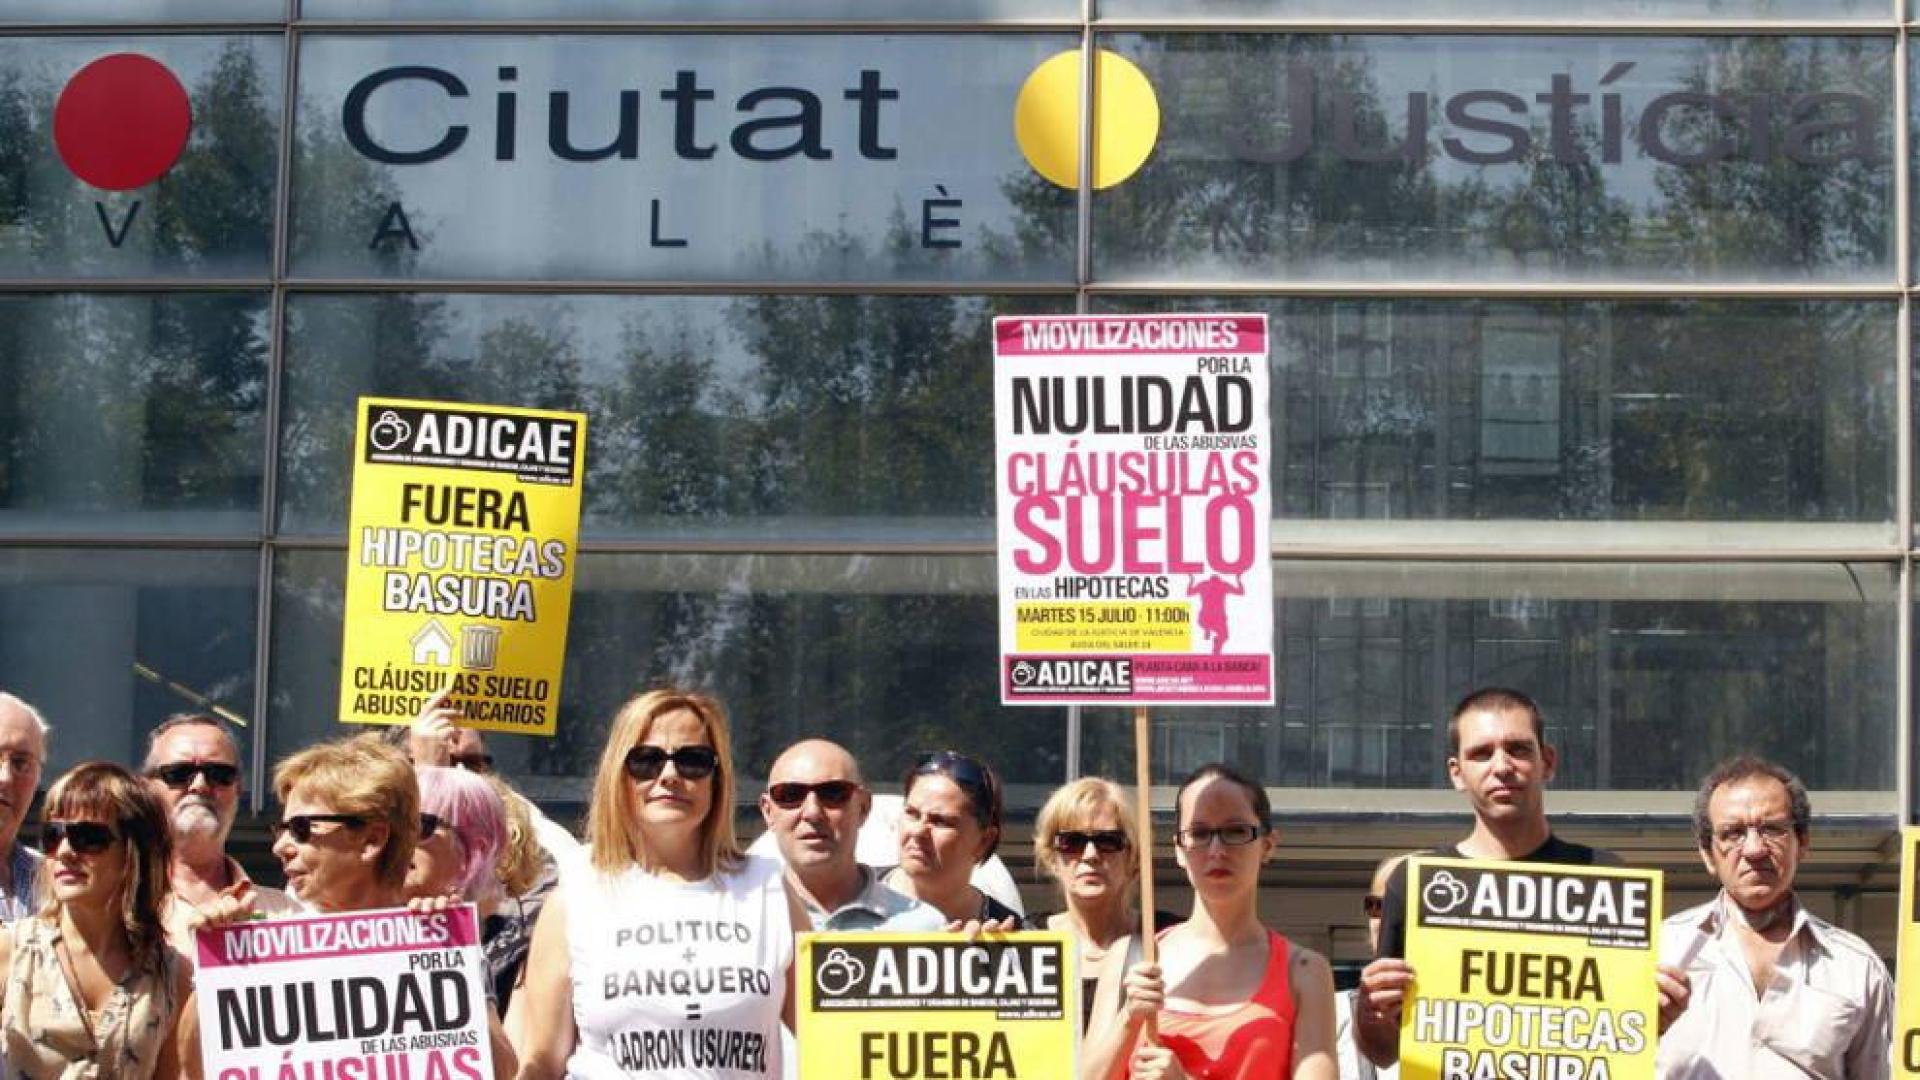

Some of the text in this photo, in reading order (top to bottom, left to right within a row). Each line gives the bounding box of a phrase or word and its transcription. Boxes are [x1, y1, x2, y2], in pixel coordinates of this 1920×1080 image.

[342, 62, 1879, 166] Ciutat Justícia
[1023, 321, 1239, 350] MOVILIZACIONES
[1198, 357, 1251, 374] POR LA
[1012, 375, 1253, 434] NULIDAD
[412, 413, 572, 464] ADICAE
[1144, 436, 1257, 449] DE LAS ABUSIVAS
[1007, 440, 1260, 497] CLÁUSULAS
[401, 483, 531, 532] FUERA
[361, 527, 566, 580] HIPOTECAS
[1013, 492, 1256, 575] SUELO
[384, 572, 536, 622] BASURA
[1015, 576, 1169, 599] EN LAS HIPOTECAS
[1017, 607, 1076, 623] MARTES
[1080, 607, 1096, 623] 15
[1098, 607, 1137, 623] JULIO
[485, 676, 549, 701] SUELO
[1037, 660, 1131, 686] ADICAE
[353, 694, 428, 717] ABUSO
[1471, 873, 1647, 925] ADICAE
[224, 912, 449, 963] MOVILIZACIONES
[616, 920, 752, 947] POLITICO
[409, 950, 465, 971] POR LA
[604, 966, 771, 1001] BANQUERO
[868, 947, 1058, 996] ADICAE
[1460, 949, 1605, 1002] FUERA
[217, 970, 471, 1051] NULIDAD
[1415, 998, 1646, 1055] HIPOTECAS
[361, 1031, 478, 1054] DE LAS ABUSIVAS
[860, 1031, 1017, 1080] FUERA
